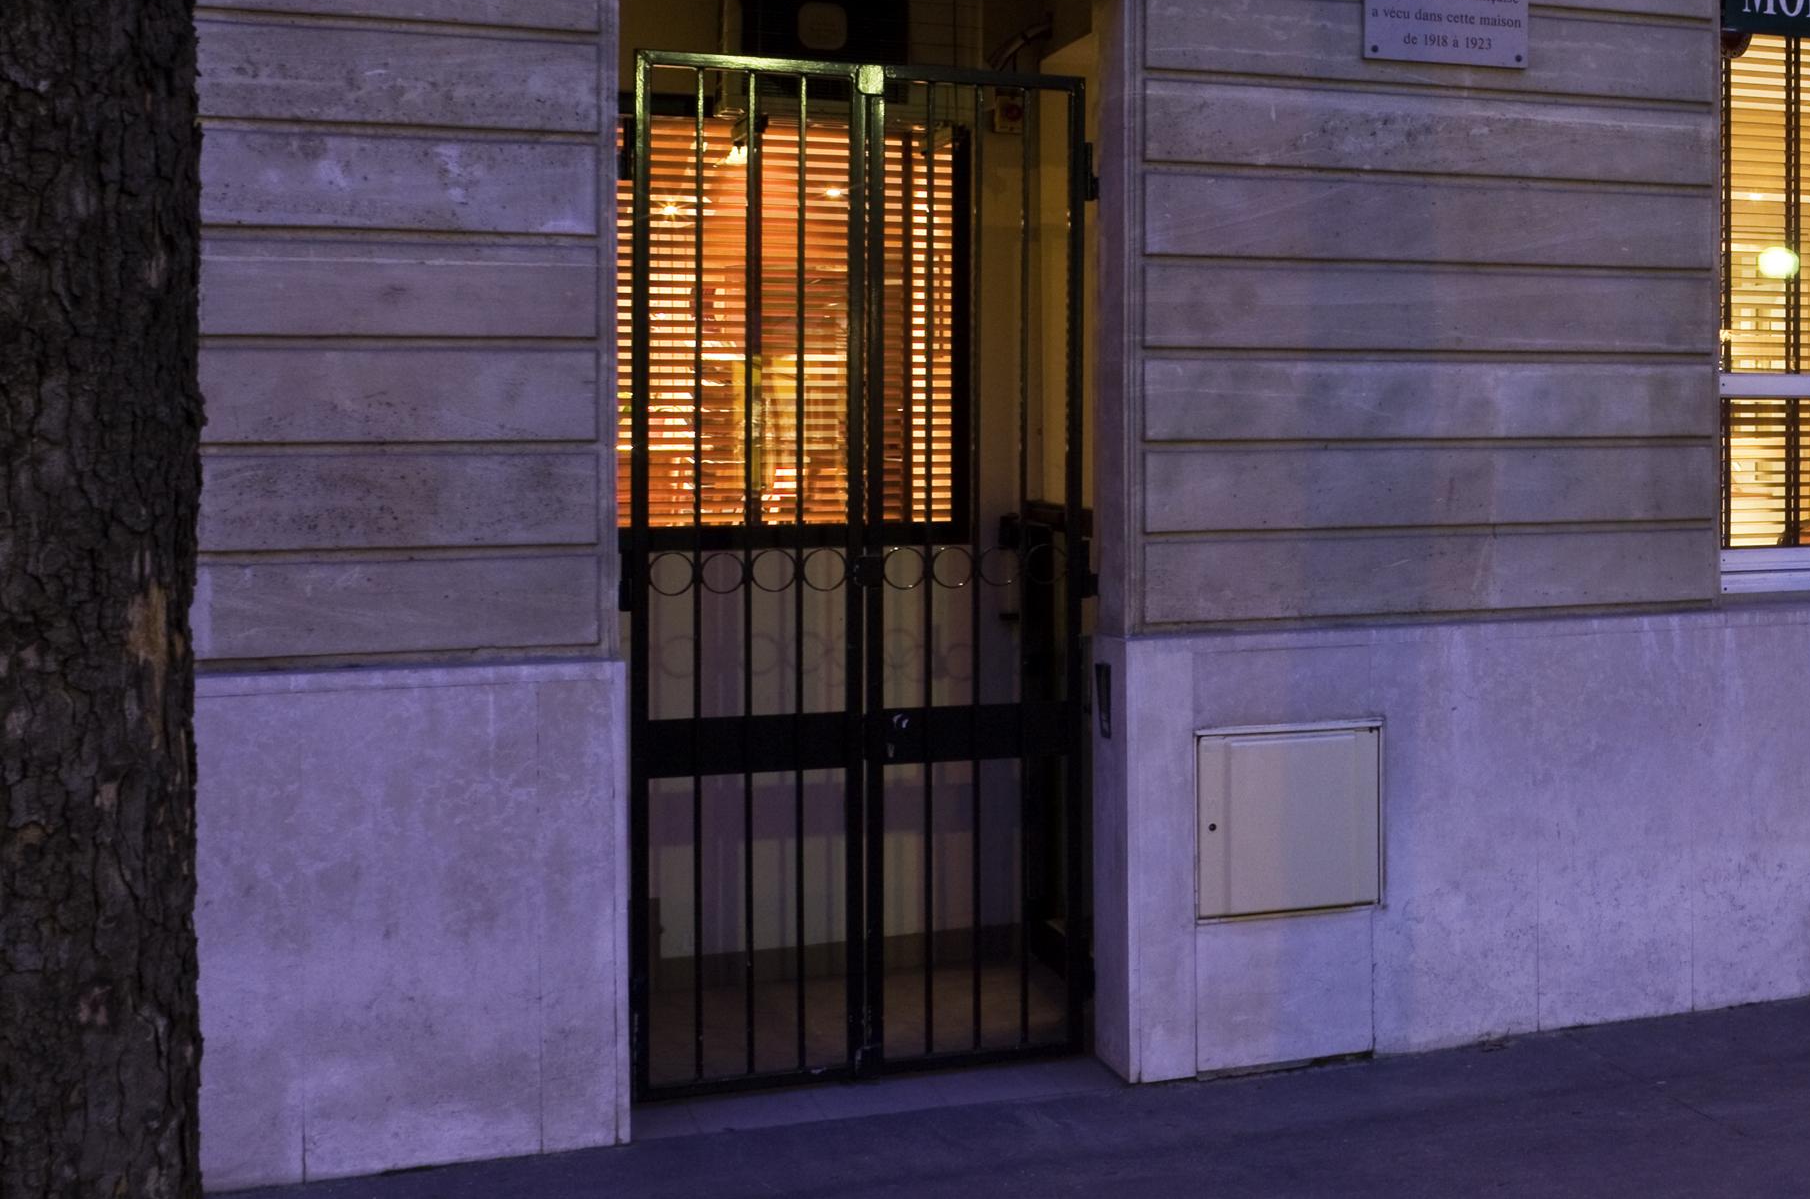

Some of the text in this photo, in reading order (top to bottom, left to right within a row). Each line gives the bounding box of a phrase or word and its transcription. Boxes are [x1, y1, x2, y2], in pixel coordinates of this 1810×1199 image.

[1371, 7, 1522, 29] a vécu dans cette maison
[1403, 33, 1418, 45] de
[1424, 34, 1449, 47] 1918
[1465, 37, 1492, 50] 1923
